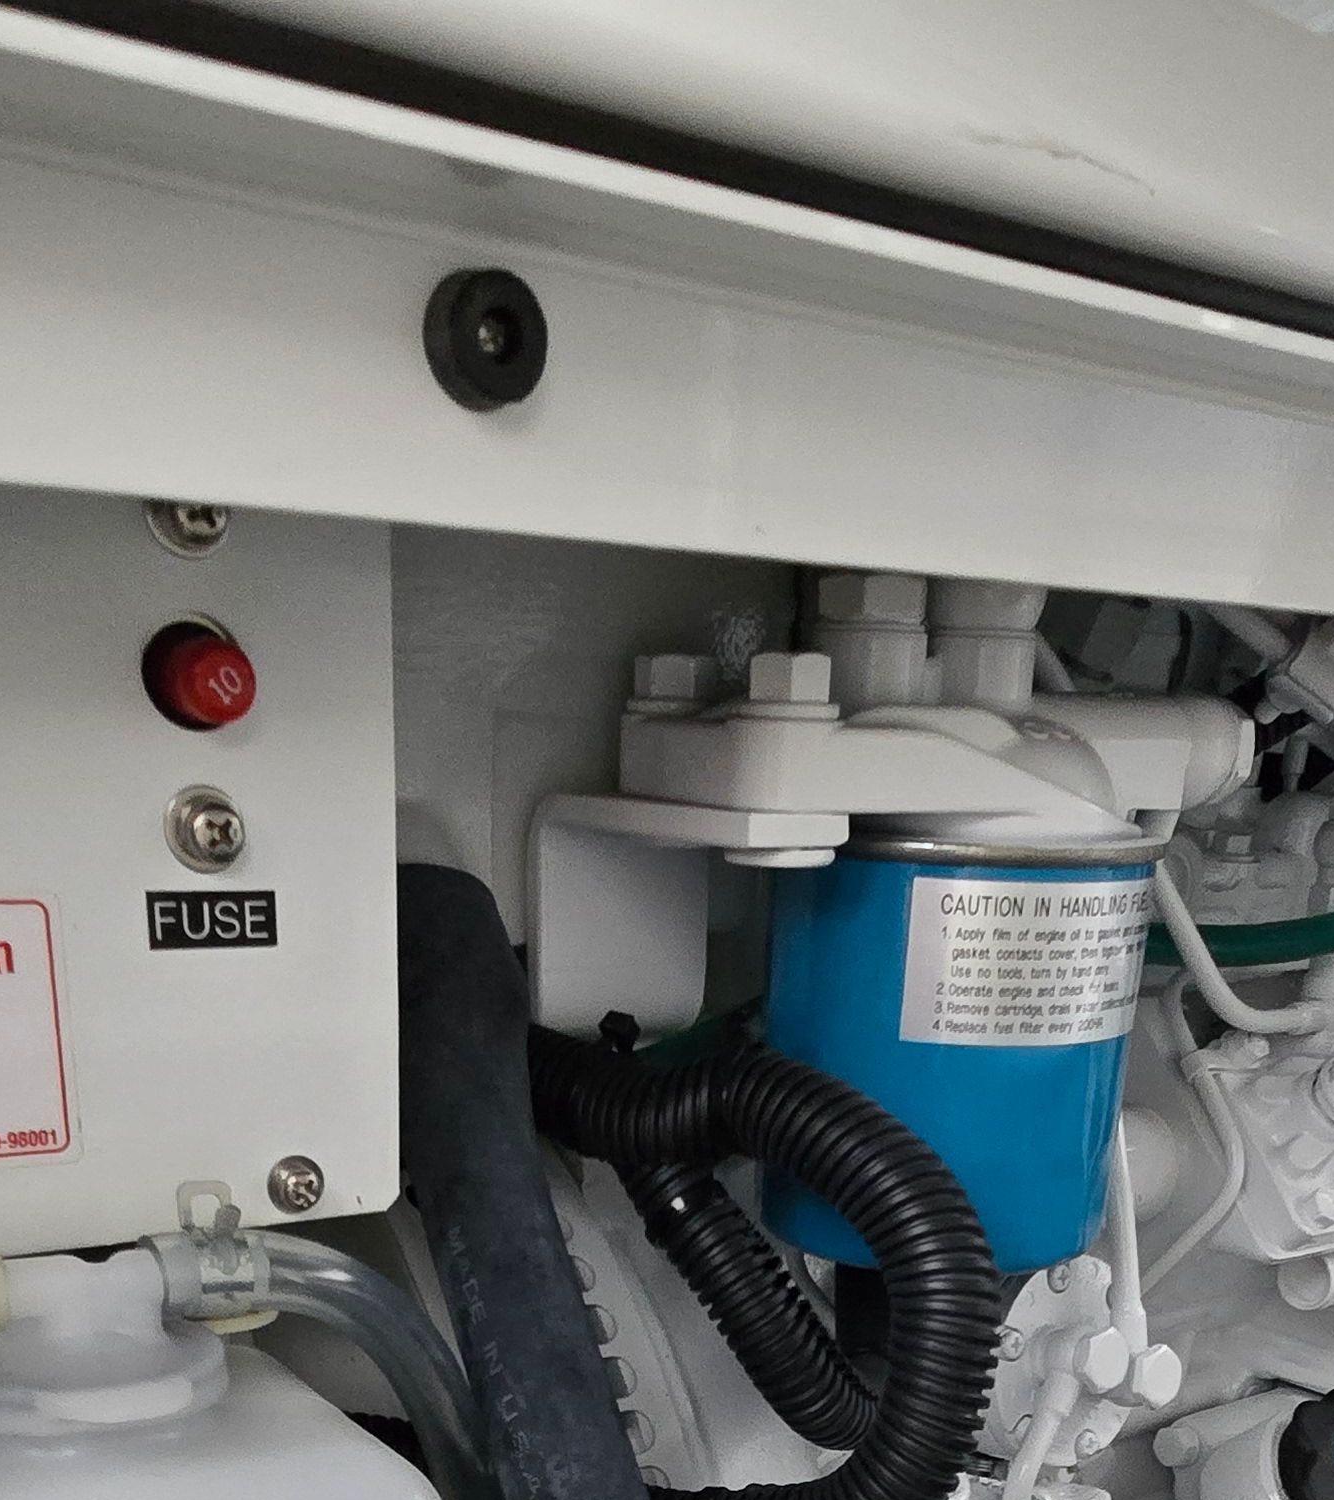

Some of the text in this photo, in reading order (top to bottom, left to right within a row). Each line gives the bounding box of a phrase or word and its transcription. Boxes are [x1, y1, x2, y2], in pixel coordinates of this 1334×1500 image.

[207, 666, 242, 706] 10
[940, 892, 1026, 917] CAUTION
[1033, 895, 1052, 918] IN
[1059, 893, 1127, 918] HANDLING
[153, 901, 269, 941] FUSE
[955, 927, 987, 943] Apply
[992, 928, 1012, 941] film
[1017, 928, 1030, 942] of
[1034, 929, 1067, 945] engine
[951, 947, 991, 962] gasket
[996, 947, 1043, 961] contacts
[950, 965, 972, 979] Use
[977, 968, 992, 980] no
[1055, 966, 1068, 981] by
[948, 983, 993, 997] Operate
[998, 986, 1033, 1000] engine
[947, 1002, 990, 1016] Remove
[945, 1020, 988, 1034] Replace
[994, 1021, 1014, 1035] fuel
[1019, 1021, 1044, 1034] filter
